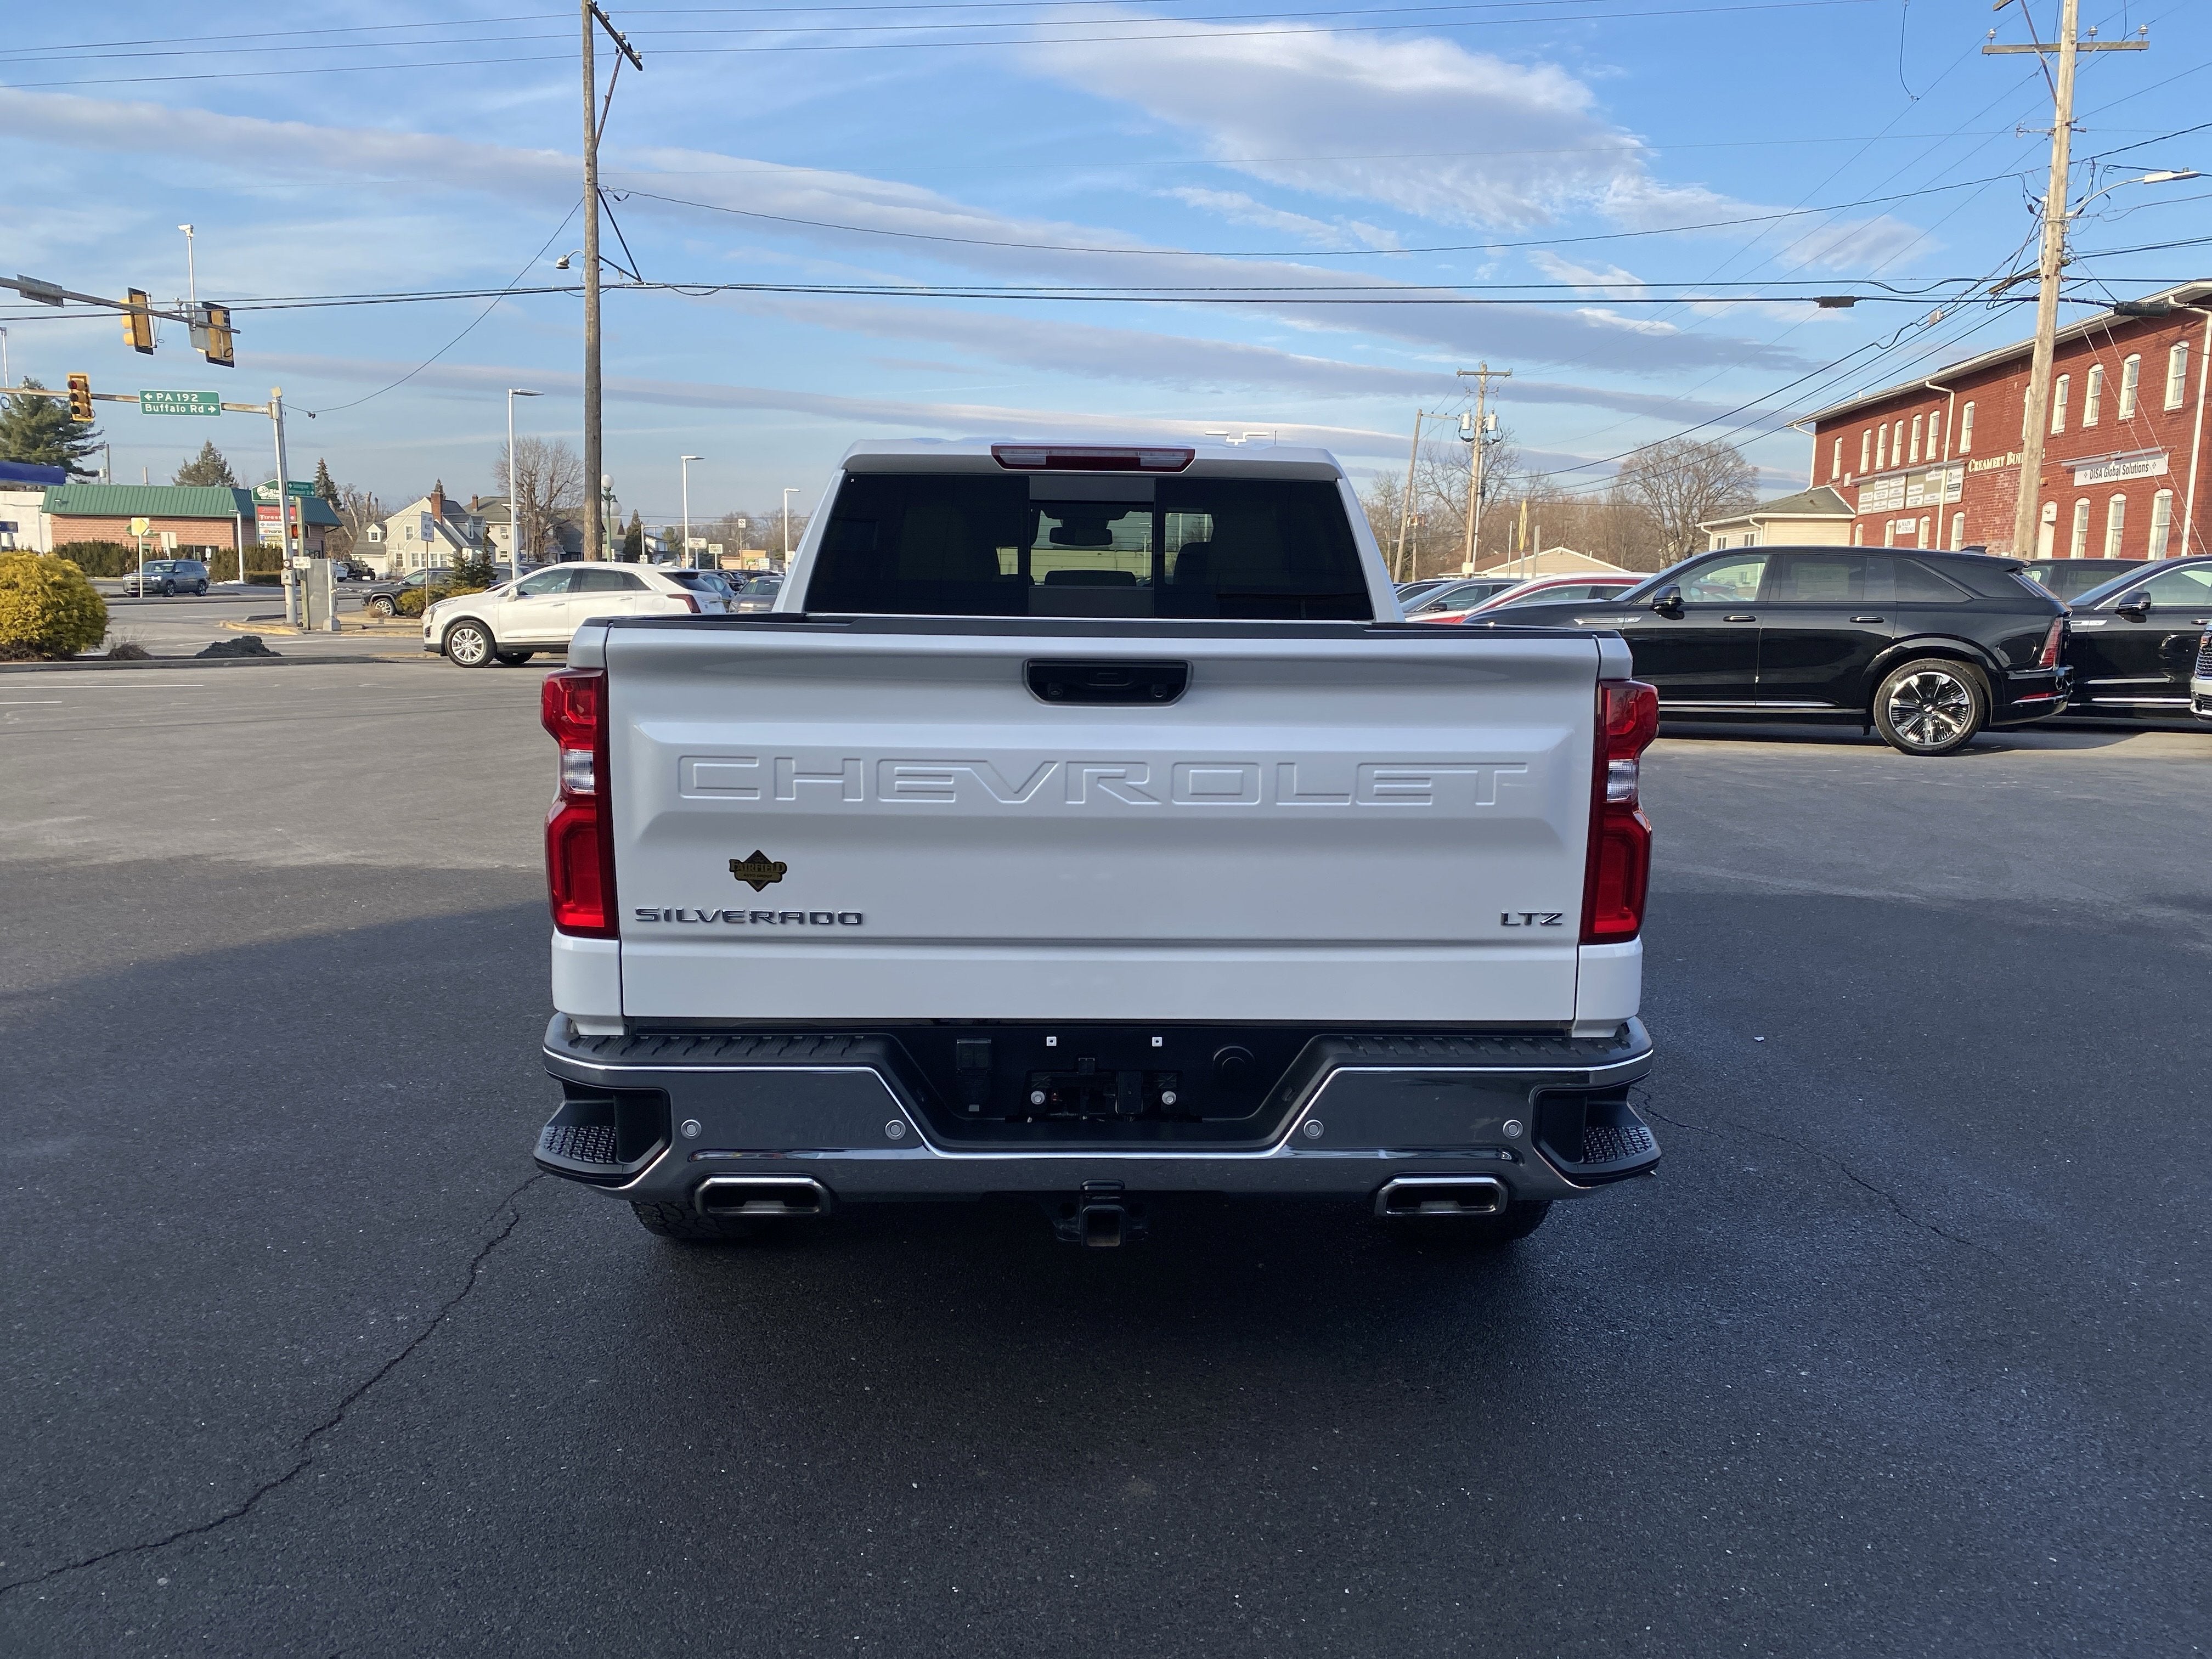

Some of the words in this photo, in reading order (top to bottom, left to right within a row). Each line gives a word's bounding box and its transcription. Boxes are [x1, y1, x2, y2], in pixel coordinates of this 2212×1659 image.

[156, 393, 173, 402] PA
[177, 393, 198, 402] 192
[145, 404, 186, 412] Buffalo
[2090, 467, 2102, 479] DISA
[2103, 464, 2121, 477] Global
[2122, 462, 2149, 475] Solutions
[678, 755, 1528, 806] CHEVROLET
[730, 860, 786, 873] FAIRFIELD
[635, 907, 863, 925] SILVERADO
[1500, 911, 1563, 926] LTZ
